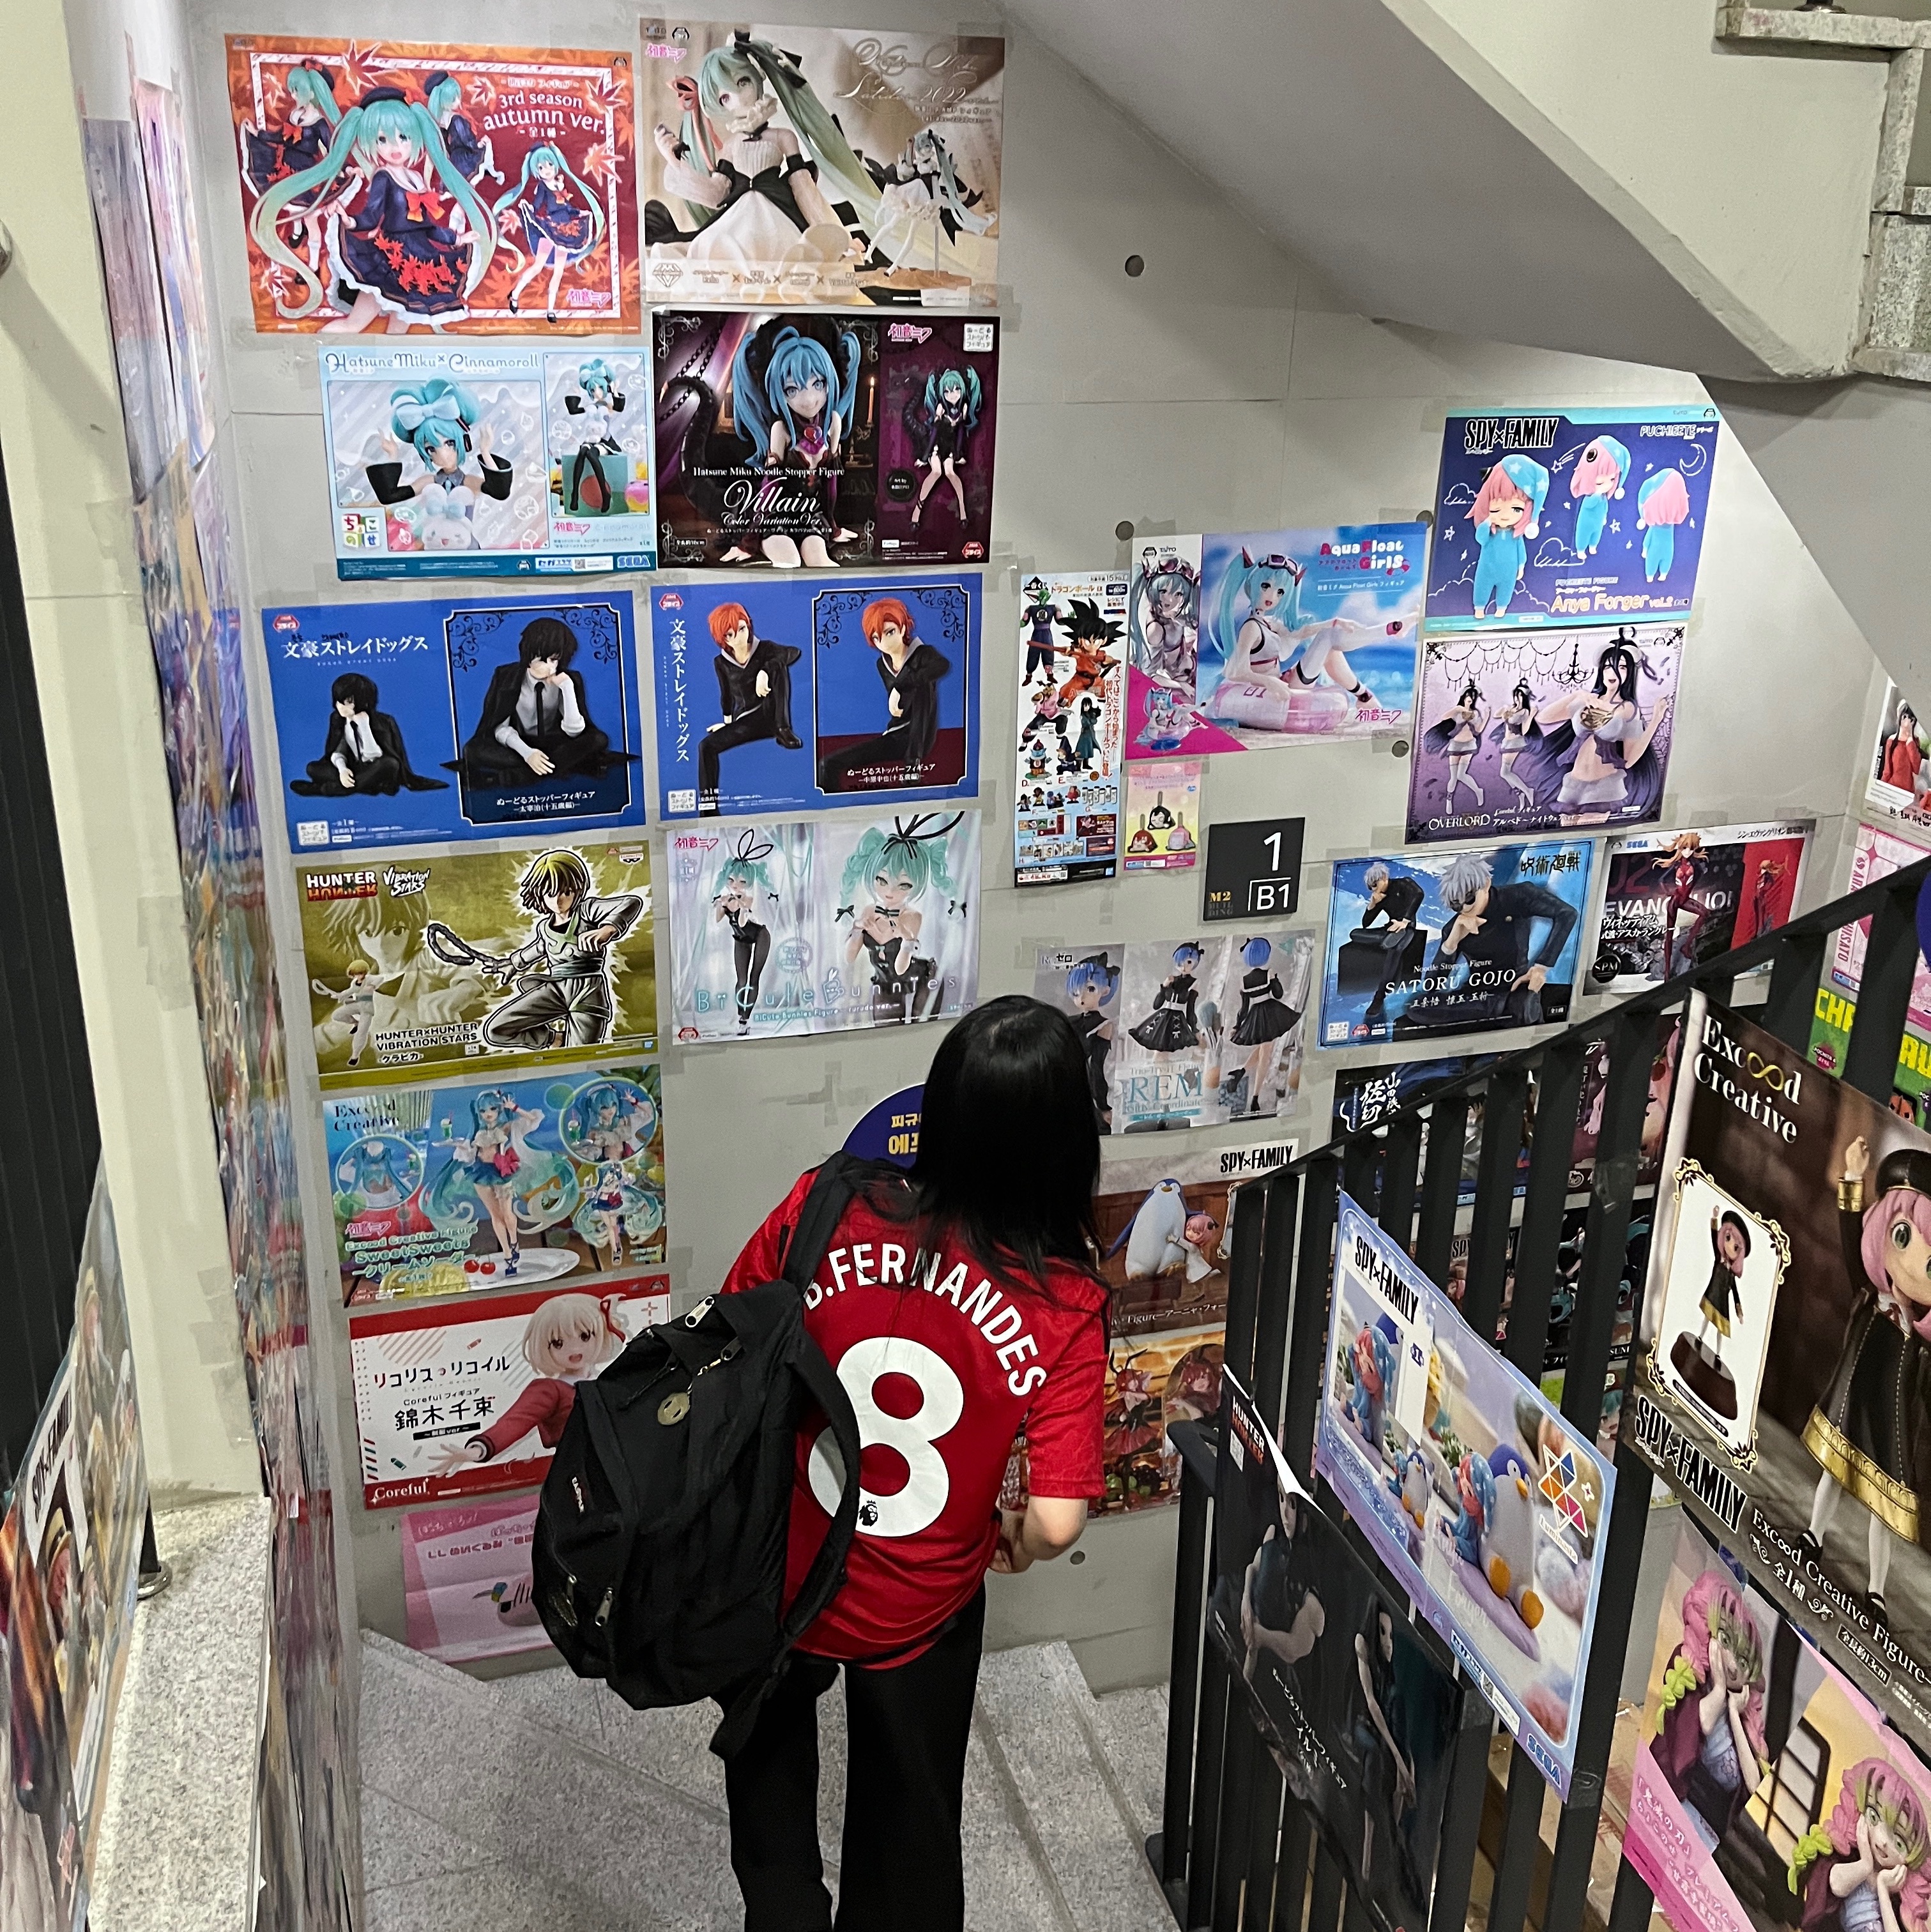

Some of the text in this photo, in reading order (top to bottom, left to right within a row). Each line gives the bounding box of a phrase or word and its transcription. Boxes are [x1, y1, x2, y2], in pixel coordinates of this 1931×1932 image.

[499, 90, 583, 109] 3rd season
[484, 109, 604, 135] autumn ver.
[326, 353, 393, 372] Hatsune
[394, 353, 436, 367] Miku
[449, 353, 538, 372] Cinnamoroll
[694, 467, 845, 478] Hatsune Miku Noodle Stopper Figure
[724, 477, 820, 514] Villain
[721, 512, 751, 525] Color
[753, 512, 799, 526] Variation
[1320, 540, 1404, 556] Aqua Float
[617, 555, 650, 568] SEGA
[1551, 595, 1591, 614] Anya
[1594, 593, 1649, 611] Forger
[281, 635, 428, 658] 文豪ストレイドッグス
[669, 618, 689, 762] 文豪ストレイドッグス
[1355, 708, 1402, 725] 初音ミク
[847, 764, 935, 776] ぬーどるストッパーフィギュア
[497, 791, 595, 805] ぬーどるストッパーフィギュア
[1428, 814, 1490, 830] OVERLORD
[675, 837, 719, 851] 初音ミク
[1263, 832, 1282, 872] 1
[1626, 840, 1649, 848] SEGA
[307, 872, 376, 888] HUNTER
[391, 881, 425, 897] STARS
[1210, 890, 1232, 903] M2
[1256, 883, 1290, 910] B1
[1414, 964, 1439, 973] Noodle
[1470, 959, 1493, 968] Figure
[1385, 969, 1516, 996] SATORU GOJO
[377, 1032, 478, 1051] VIBRATION STARS
[1127, 1071, 1203, 1103] REM
[1694, 1053, 1797, 1143] Creative
[891, 1113, 920, 1128] 피규
[1220, 1145, 1294, 1174] SPY×FAMILY
[388, 1231, 439, 1245] Creative
[355, 1239, 471, 1264] SweetSweets
[1354, 1235, 1419, 1326] SPY×FAMILY
[404, 1388, 480, 1406] Coreful フィギュア
[394, 1396, 496, 1431] 錦木千束
[1232, 1396, 1265, 1449] HUNTER
[809, 1337, 964, 1537] 8
[1635, 1394, 1748, 1534] SPY×FAMILY
[374, 1481, 428, 1499] Coreful
[1806, 1560, 1869, 1630] Creative
[1872, 1622, 1925, 1684] Figure
[1527, 1733, 1561, 1789] SEGA
